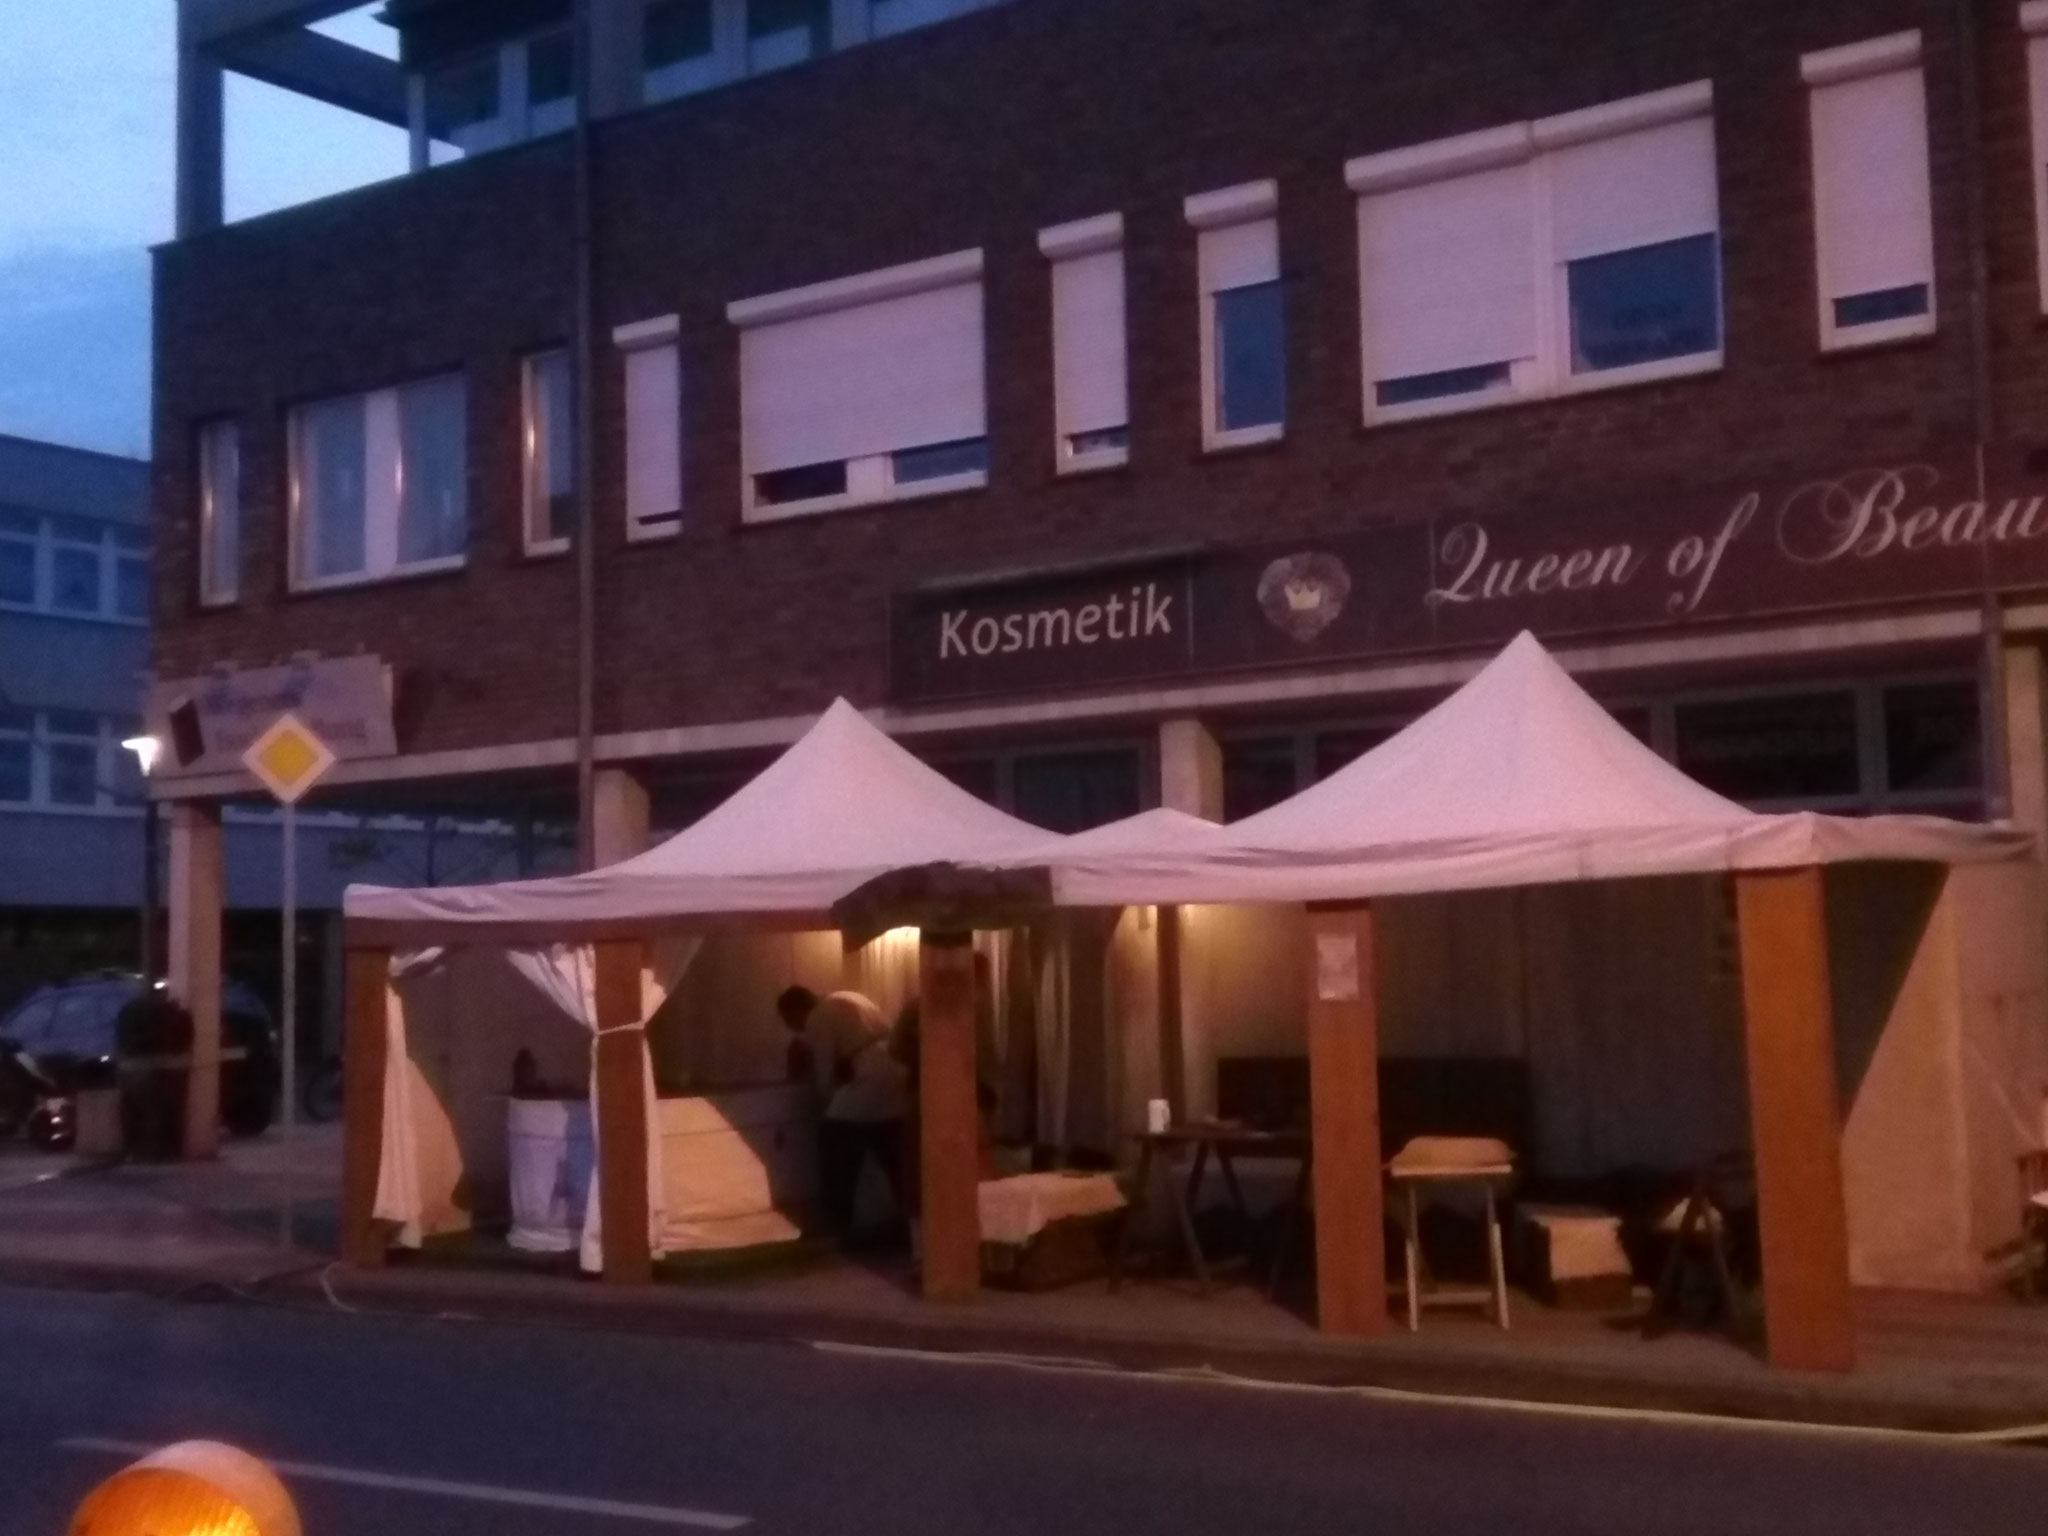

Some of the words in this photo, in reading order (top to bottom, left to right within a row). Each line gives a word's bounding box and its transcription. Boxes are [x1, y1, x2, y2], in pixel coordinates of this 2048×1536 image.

[1424, 521, 1646, 606] Queen
[1665, 491, 1760, 616] of
[940, 582, 1173, 660] Kosmetik
